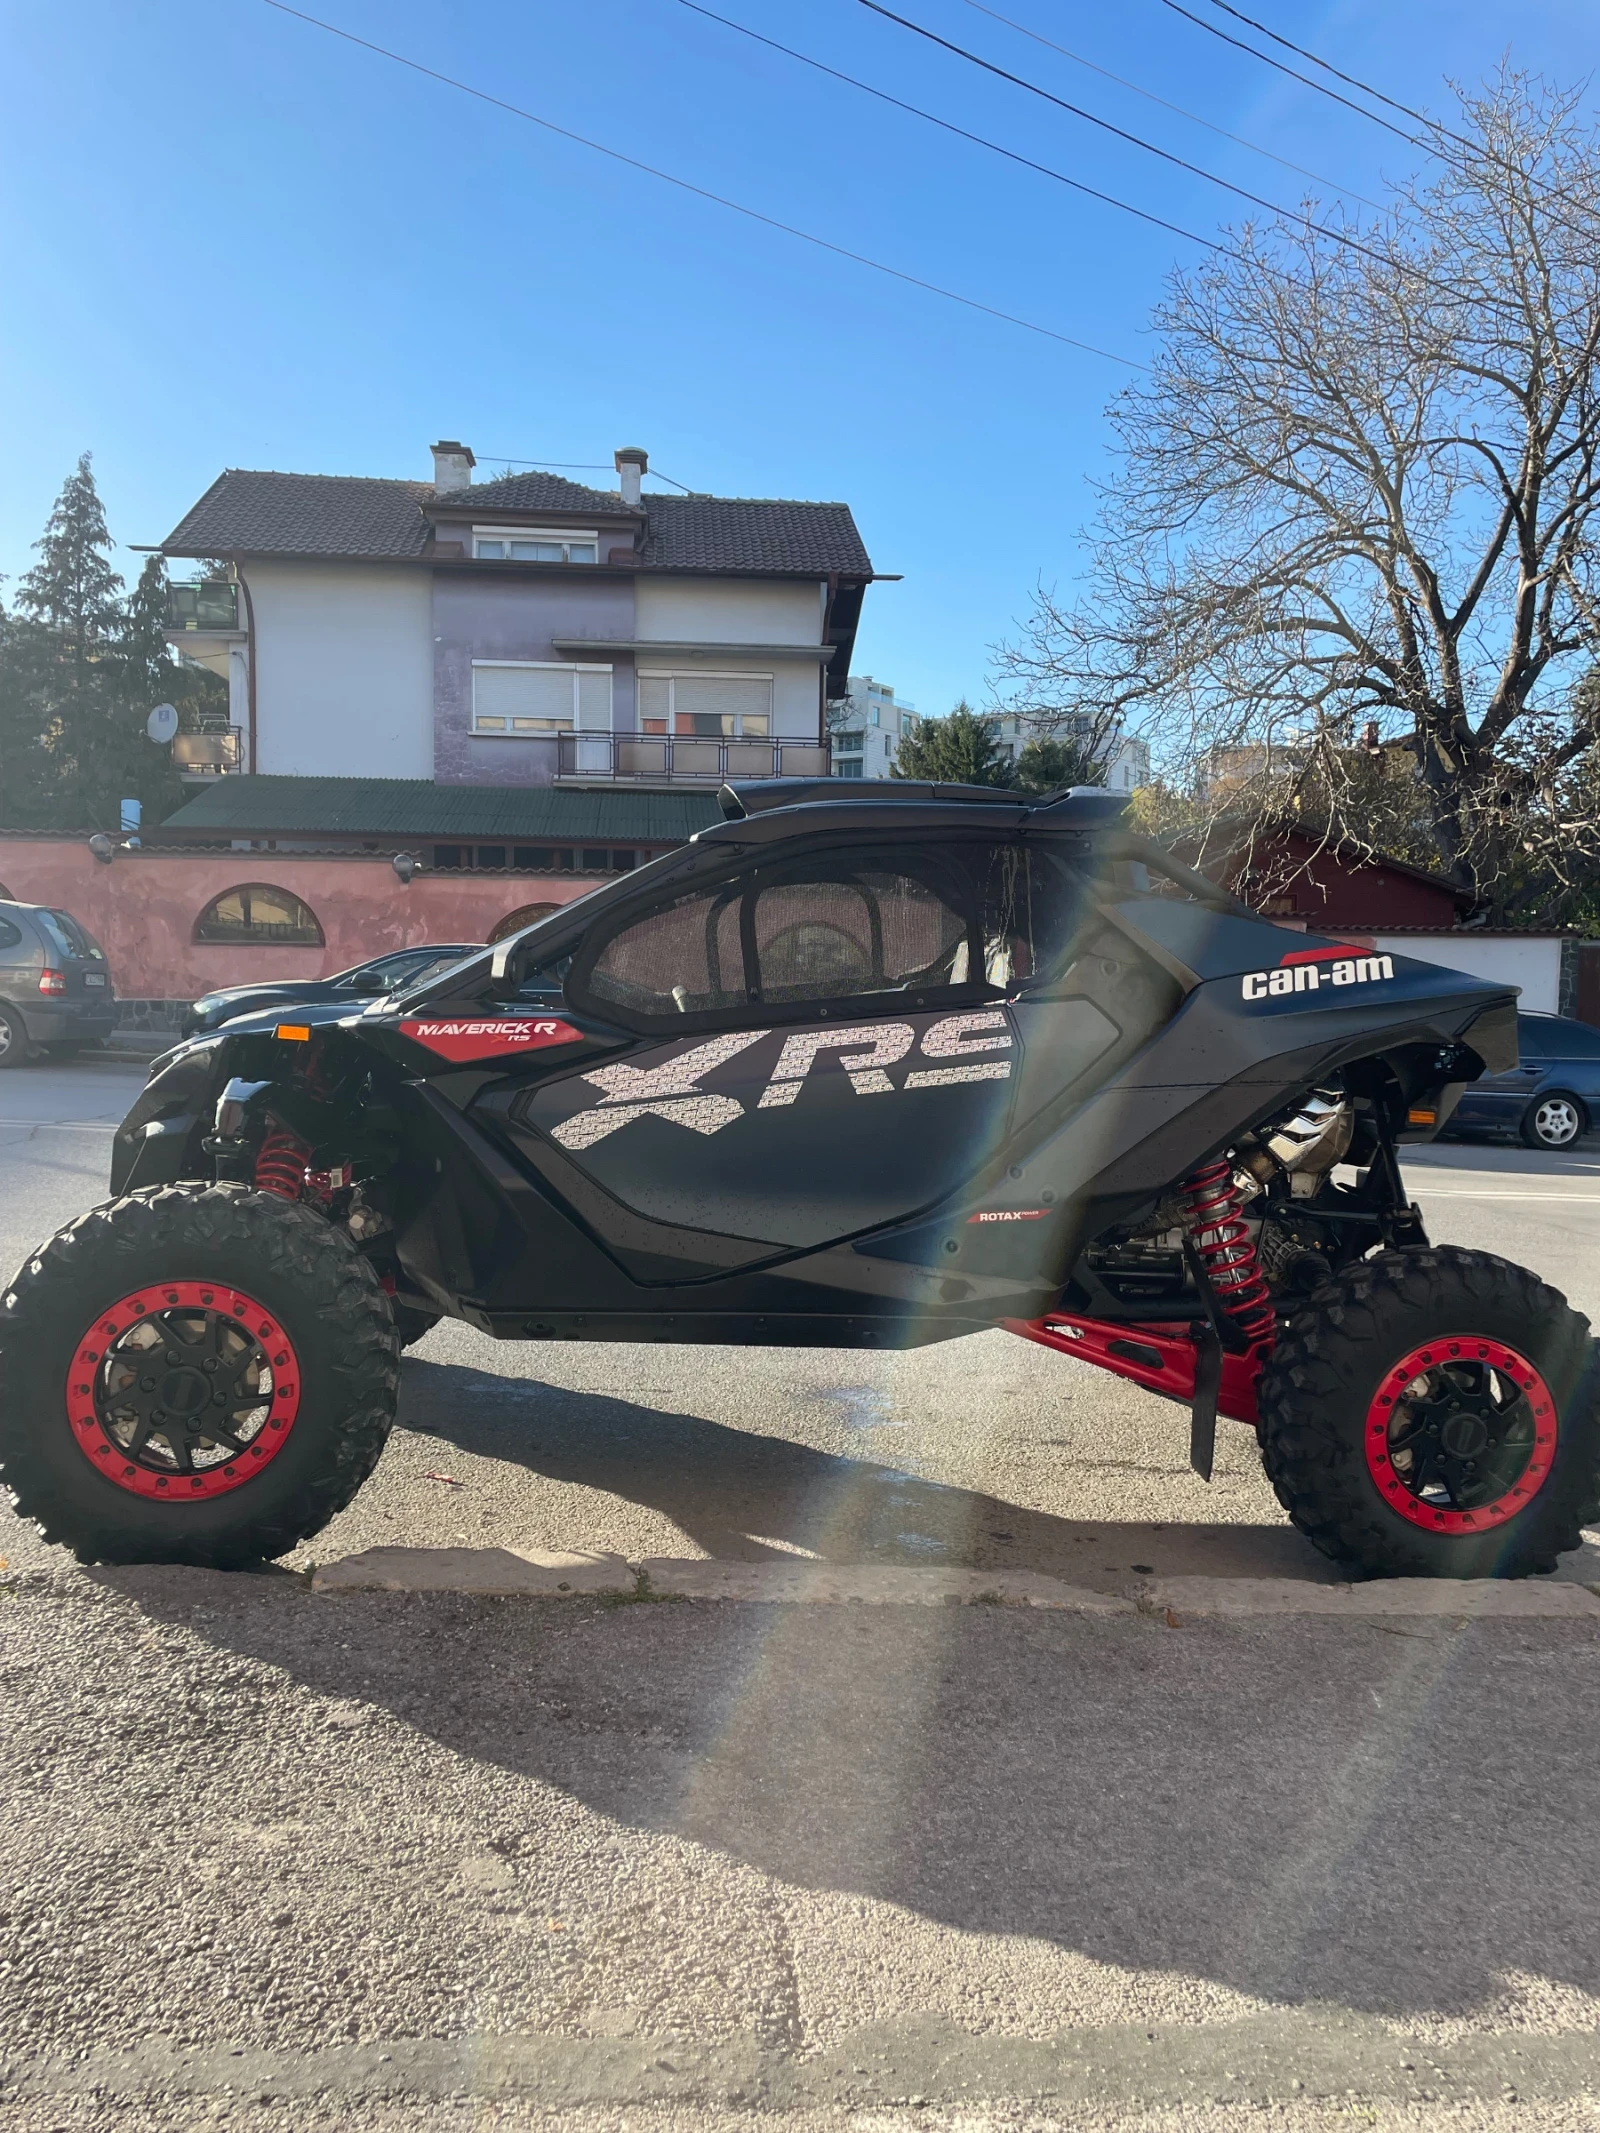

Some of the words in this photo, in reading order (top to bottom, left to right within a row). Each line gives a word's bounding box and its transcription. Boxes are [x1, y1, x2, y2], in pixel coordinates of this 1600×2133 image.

[1242, 955, 1394, 1000] can-am
[417, 1022, 533, 1036] MAVERICK
[533, 1022, 557, 1034] R
[979, 1211, 1021, 1221] ROTAX
